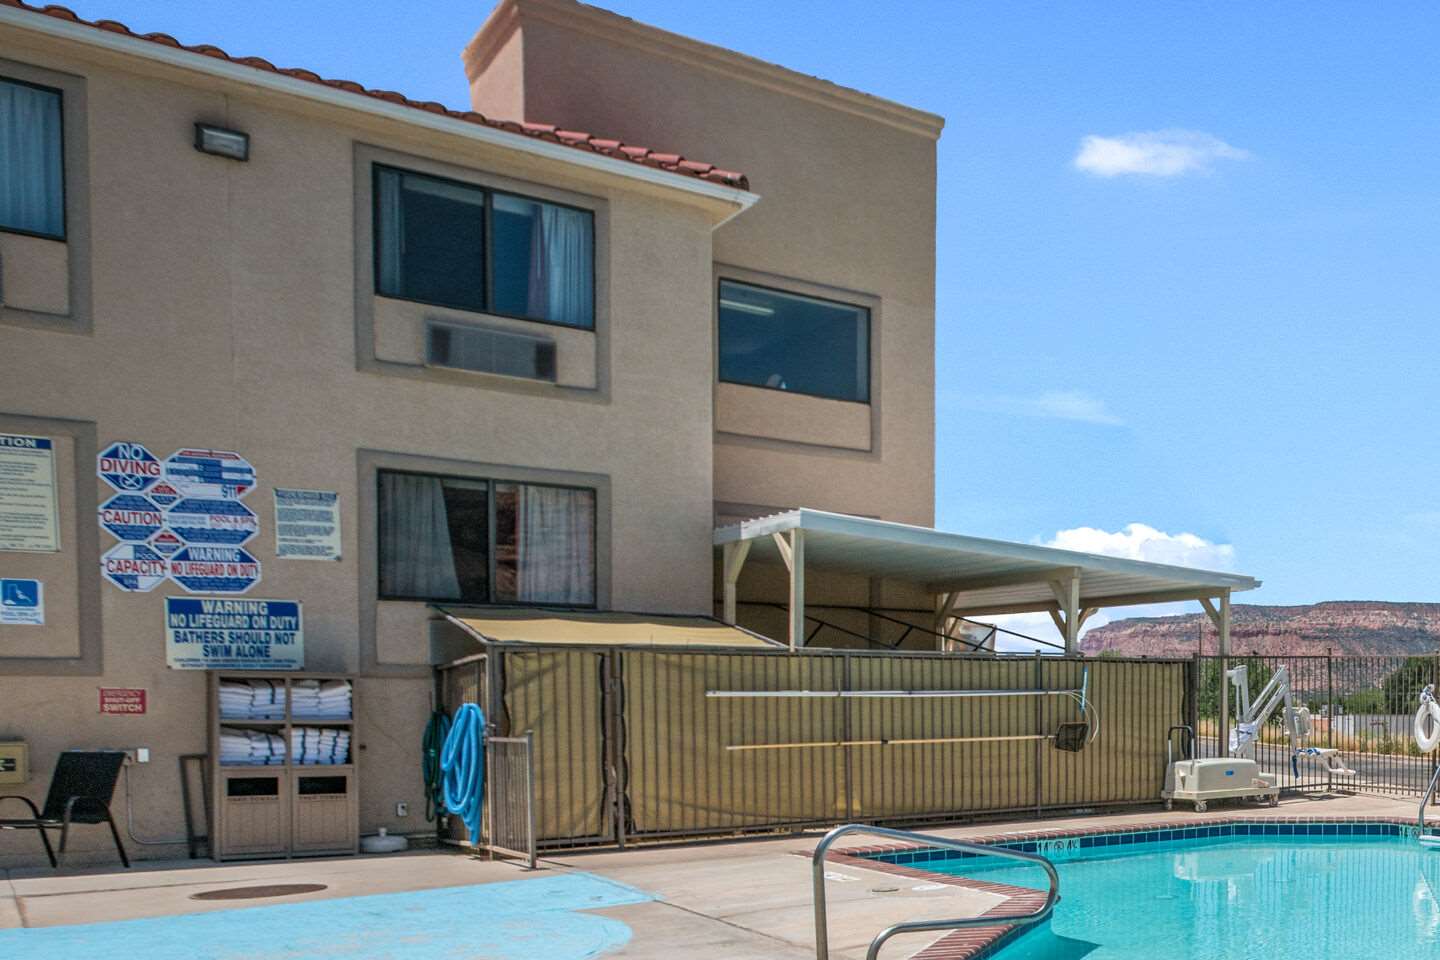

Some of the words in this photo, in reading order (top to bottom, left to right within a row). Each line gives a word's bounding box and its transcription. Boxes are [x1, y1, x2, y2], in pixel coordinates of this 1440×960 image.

[118, 445, 144, 460] NO
[101, 459, 161, 475] DIVING
[103, 511, 162, 525] CAUTION
[188, 547, 240, 562] WARNING
[107, 560, 165, 575] CAPACITY
[171, 563, 182, 575] NO
[185, 563, 224, 576] LIFEGUARD
[227, 564, 238, 576] ON
[240, 564, 257, 577] DUTY
[201, 600, 269, 615] WARNING
[170, 613, 186, 627] NO
[188, 614, 249, 629] LIFEGUARD
[252, 615, 268, 629] ON
[270, 616, 297, 630] DUTY
[174, 630, 225, 644] BATHERS
[228, 631, 271, 645] SHOULD
[274, 632, 296, 645] NOT
[202, 644, 232, 658] SWIM
[235, 645, 271, 658] ALONE
[103, 703, 143, 712] SWITCH
